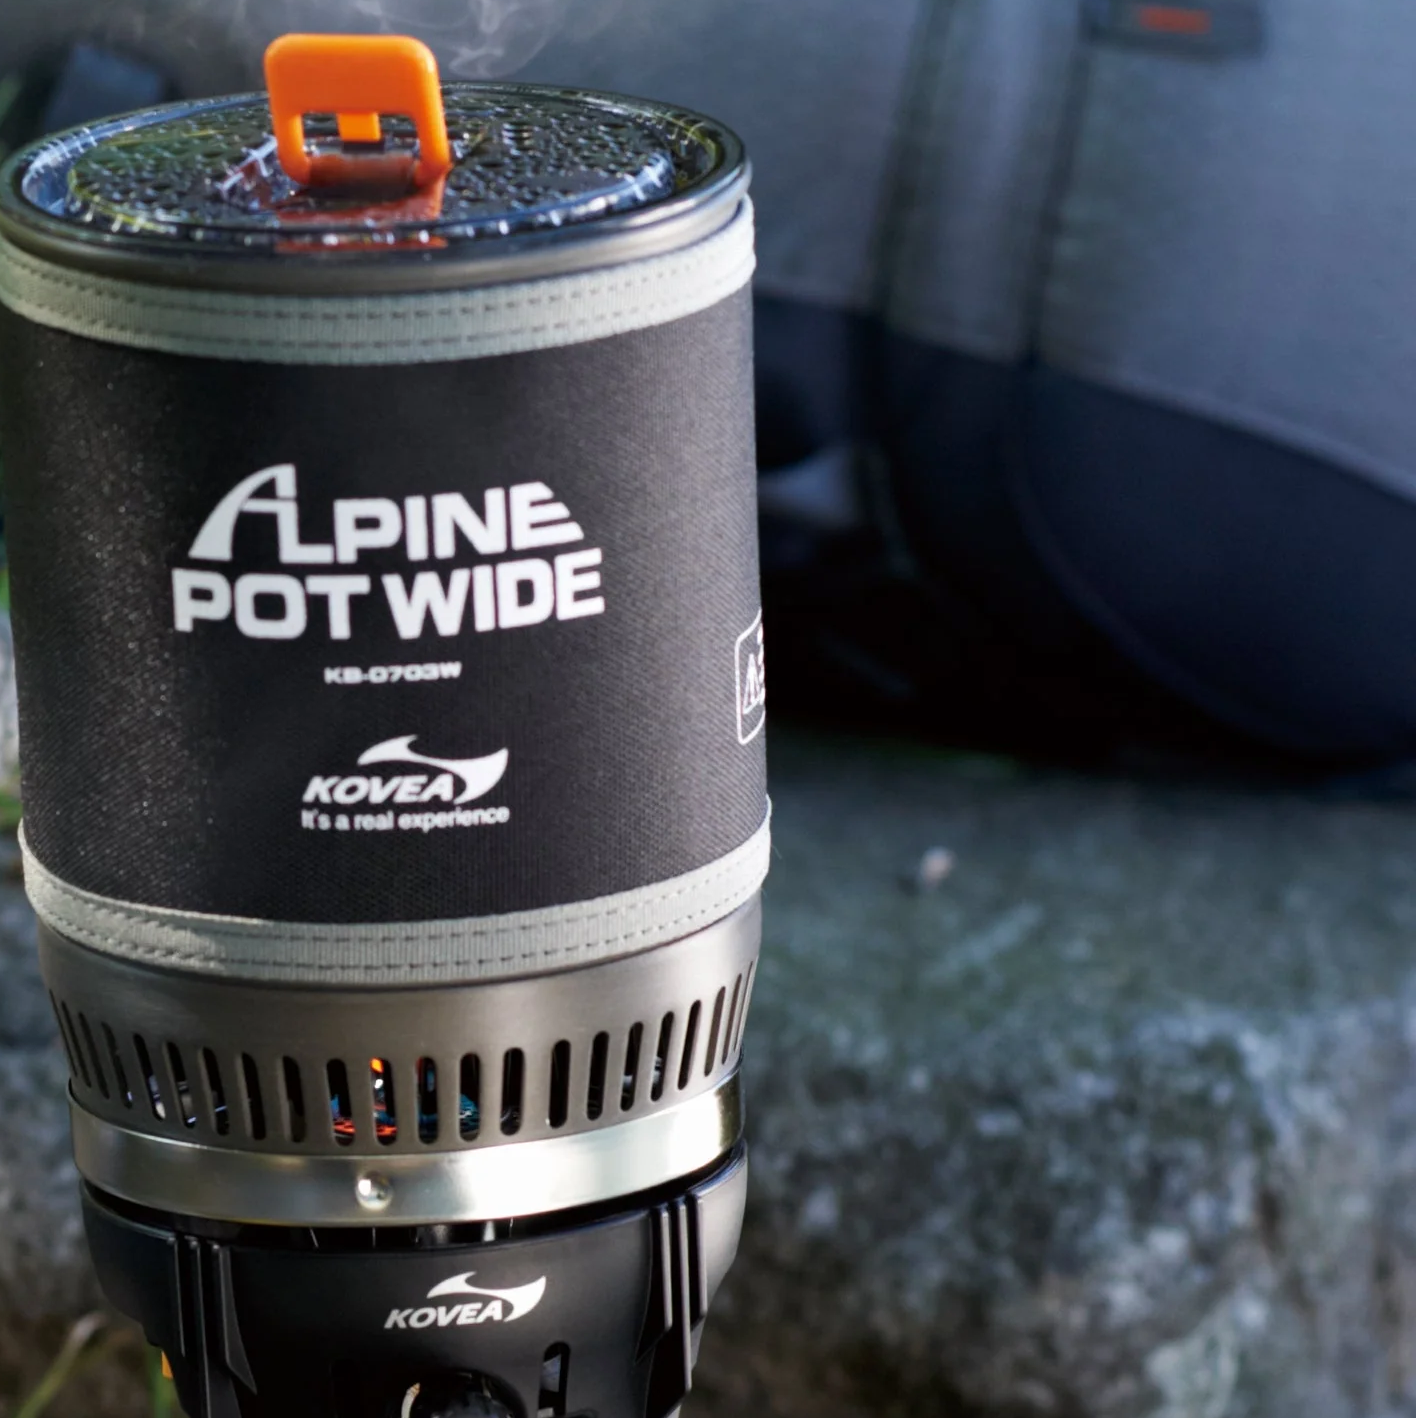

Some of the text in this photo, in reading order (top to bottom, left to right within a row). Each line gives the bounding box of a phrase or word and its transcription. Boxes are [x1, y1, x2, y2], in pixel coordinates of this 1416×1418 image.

[187, 463, 585, 564] ALPINE
[171, 547, 606, 640] POT WIDE
[324, 661, 462, 684] KB-0703W
[301, 773, 455, 804] KOVEA
[301, 806, 511, 833] It's a real experience
[384, 1299, 503, 1329] KOVEA
